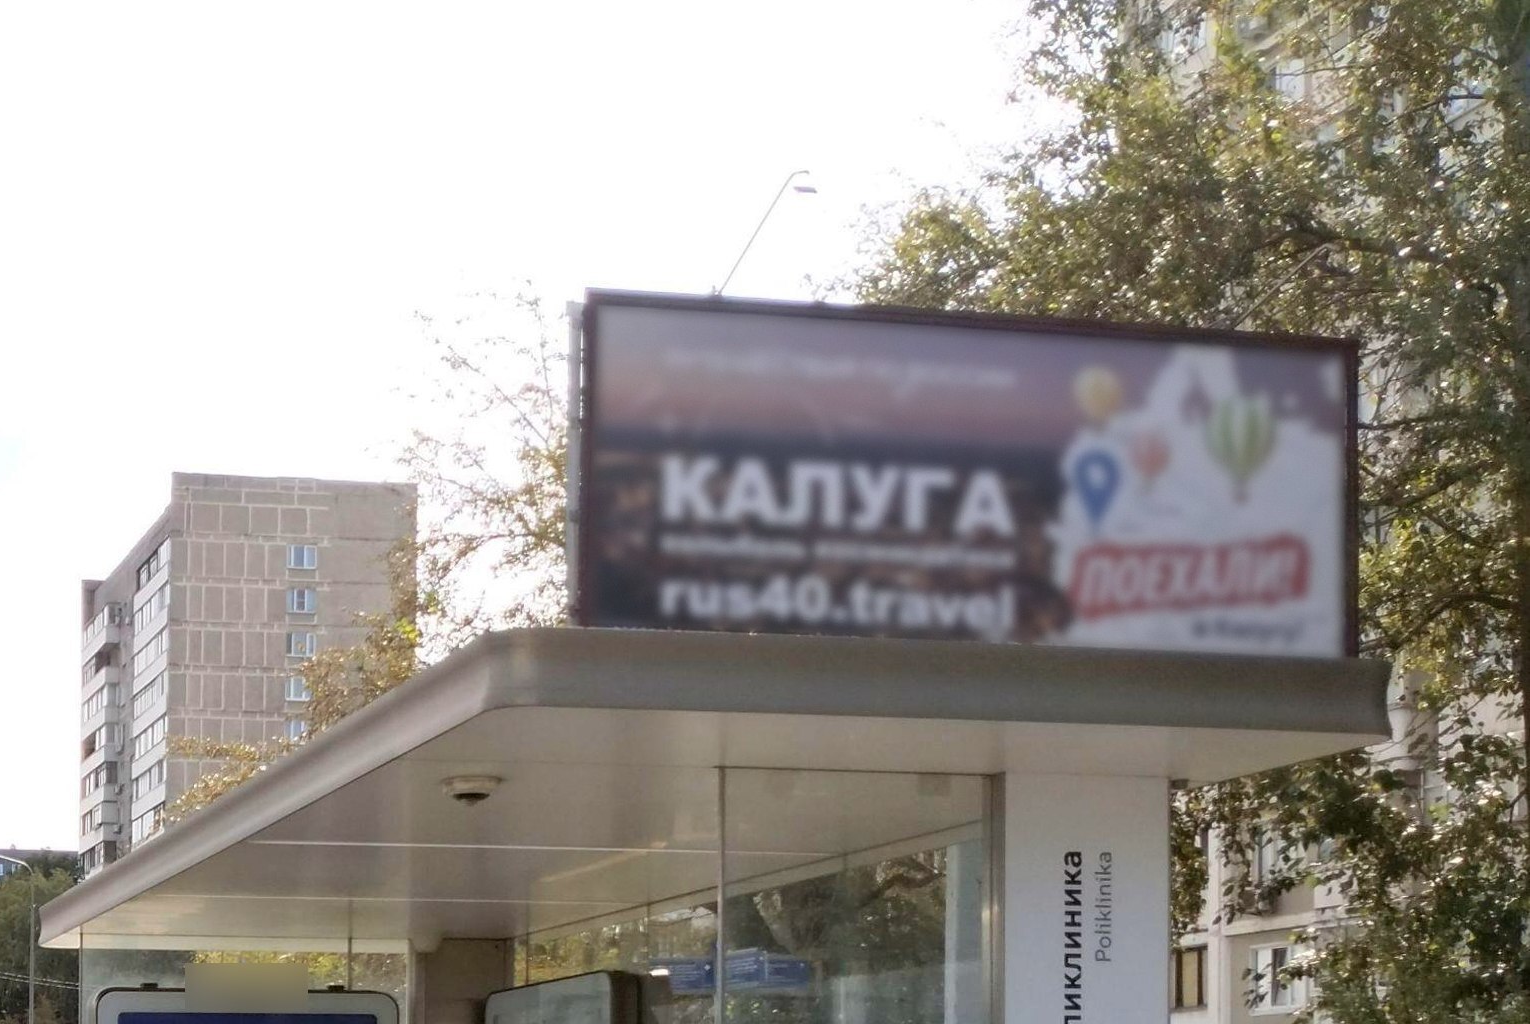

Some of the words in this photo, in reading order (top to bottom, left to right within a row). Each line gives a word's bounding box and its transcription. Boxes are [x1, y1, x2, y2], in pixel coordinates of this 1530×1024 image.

[661, 454, 1015, 538] КАЛУГА
[659, 573, 1016, 633] rus40.travel
[1095, 851, 1112, 962] Poliklinika
